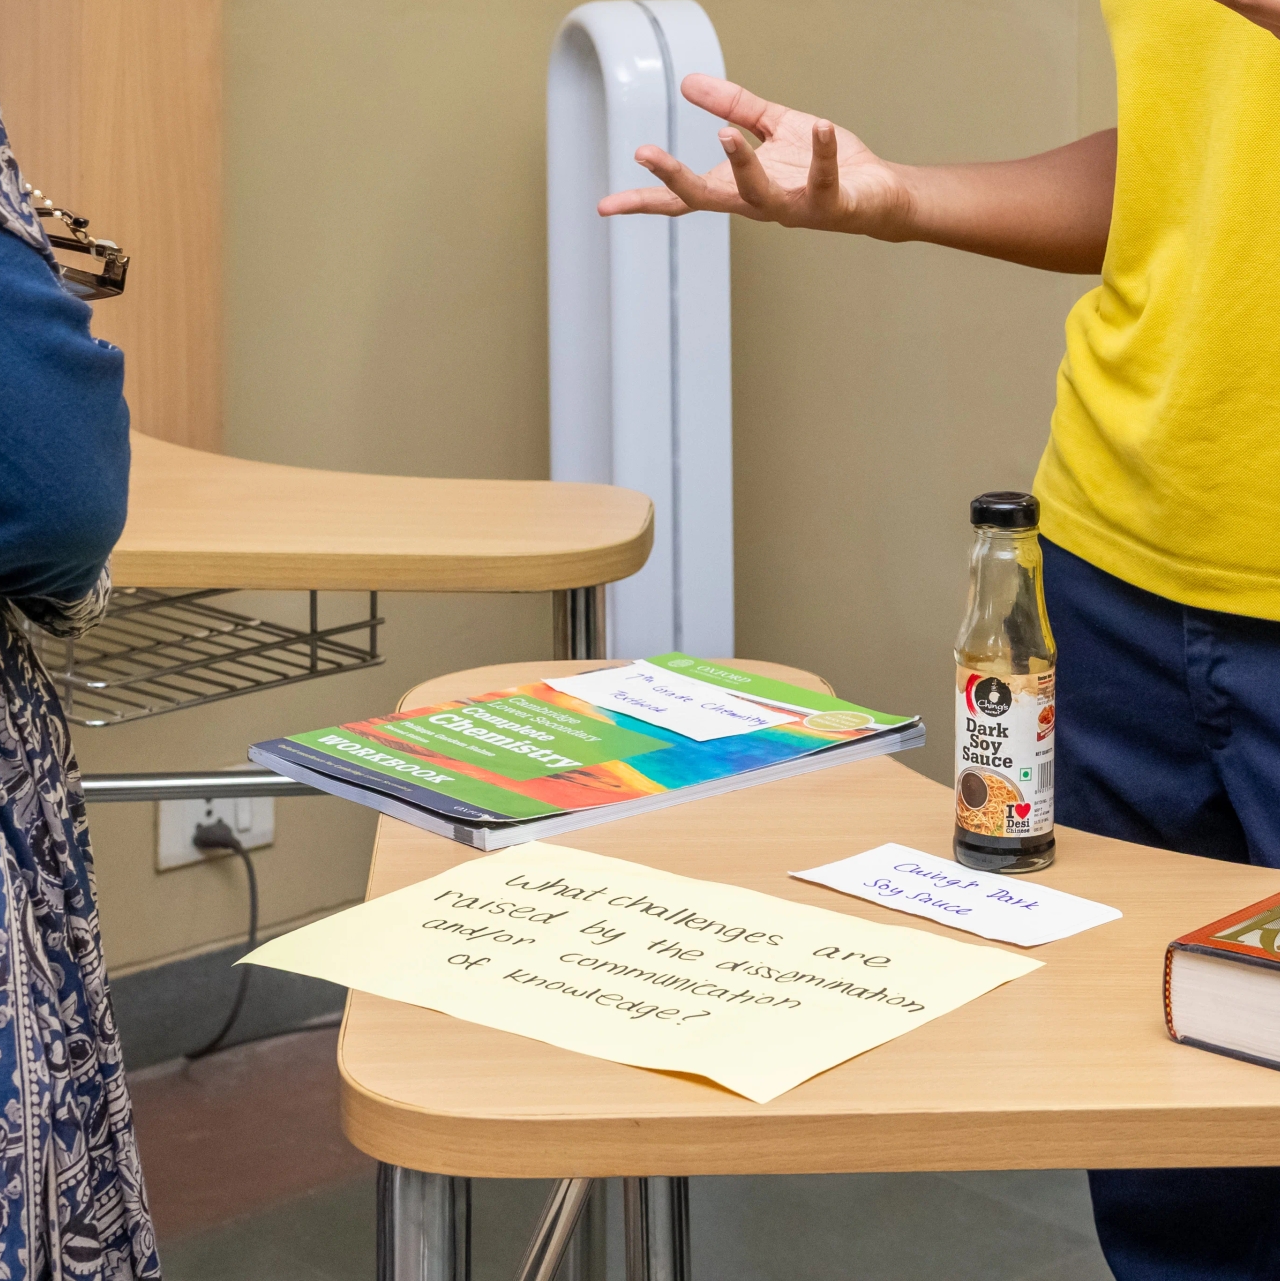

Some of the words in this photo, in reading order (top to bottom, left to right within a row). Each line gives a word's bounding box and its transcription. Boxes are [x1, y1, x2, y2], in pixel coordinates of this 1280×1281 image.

[508, 696, 582, 725] Cambridge
[977, 699, 1009, 713] Ching's
[461, 706, 556, 742] Complete
[486, 701, 532, 720] Lower
[529, 715, 603, 742] Secondary
[966, 717, 1009, 738] Dark
[428, 713, 584, 768] Chemistry
[970, 734, 1003, 755] Soy
[317, 734, 455, 784] WORKBOOK
[962, 746, 1013, 768] Sauce
[1006, 818, 1030, 828] Desi
[864, 878, 904, 897] Soy
[985, 888, 1042, 911] Dark
[608, 894, 784, 946] challenges
[812, 946, 891, 968] are
[422, 919, 536, 946] and/or
[559, 952, 802, 1009] communication
[433, 889, 569, 925] raised
[579, 919, 627, 946] by
[646, 938, 705, 961] the
[715, 960, 926, 1013] dissemination
[447, 953, 491, 970] of
